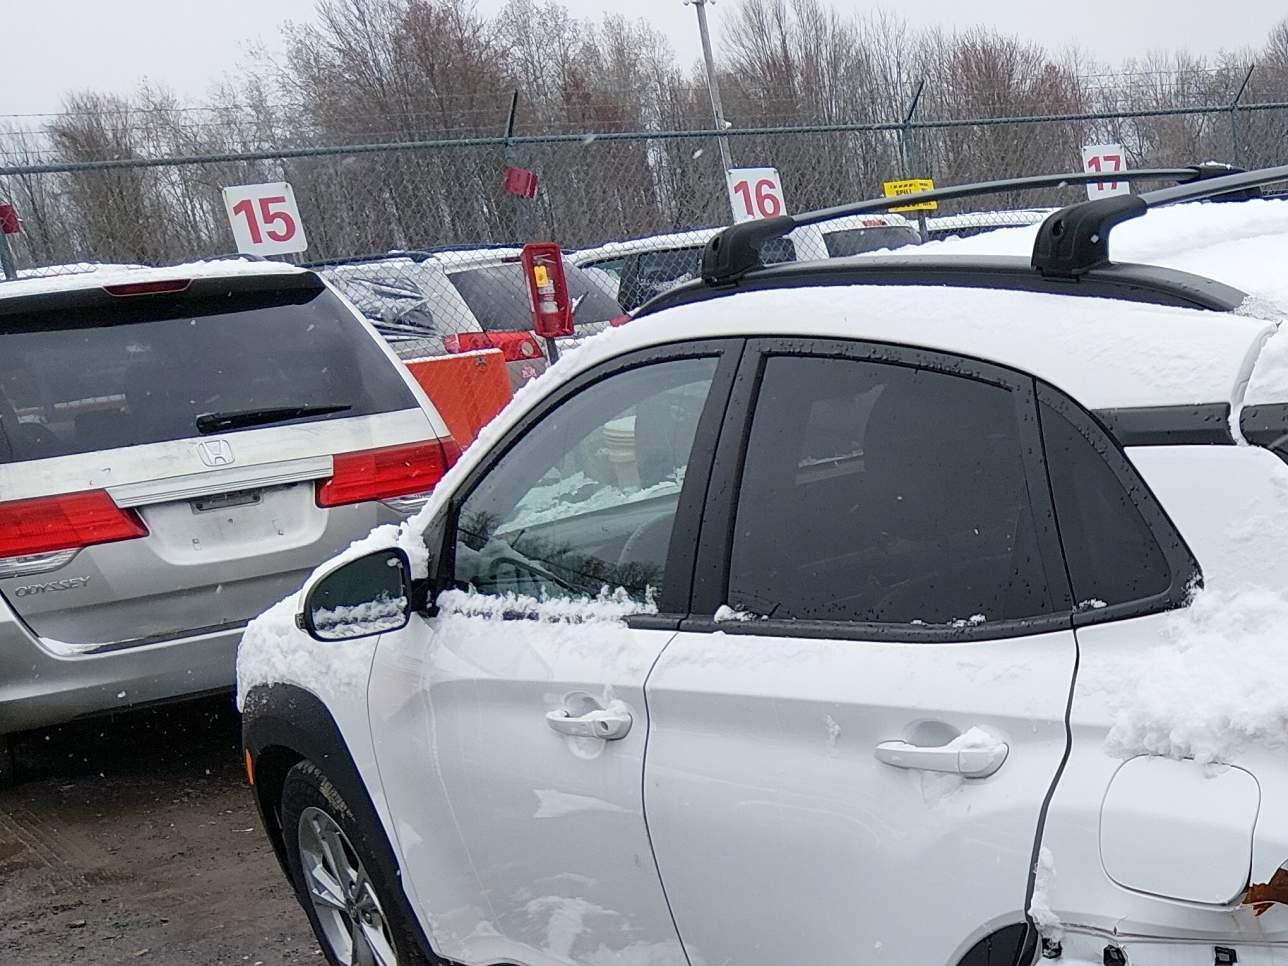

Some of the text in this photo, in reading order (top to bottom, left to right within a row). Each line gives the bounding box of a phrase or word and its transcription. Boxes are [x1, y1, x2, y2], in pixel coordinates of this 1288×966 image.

[1088, 155, 1121, 191] 17
[734, 179, 781, 220] 16
[232, 196, 296, 244] 15
[15, 575, 91, 597] ODYSSEY
